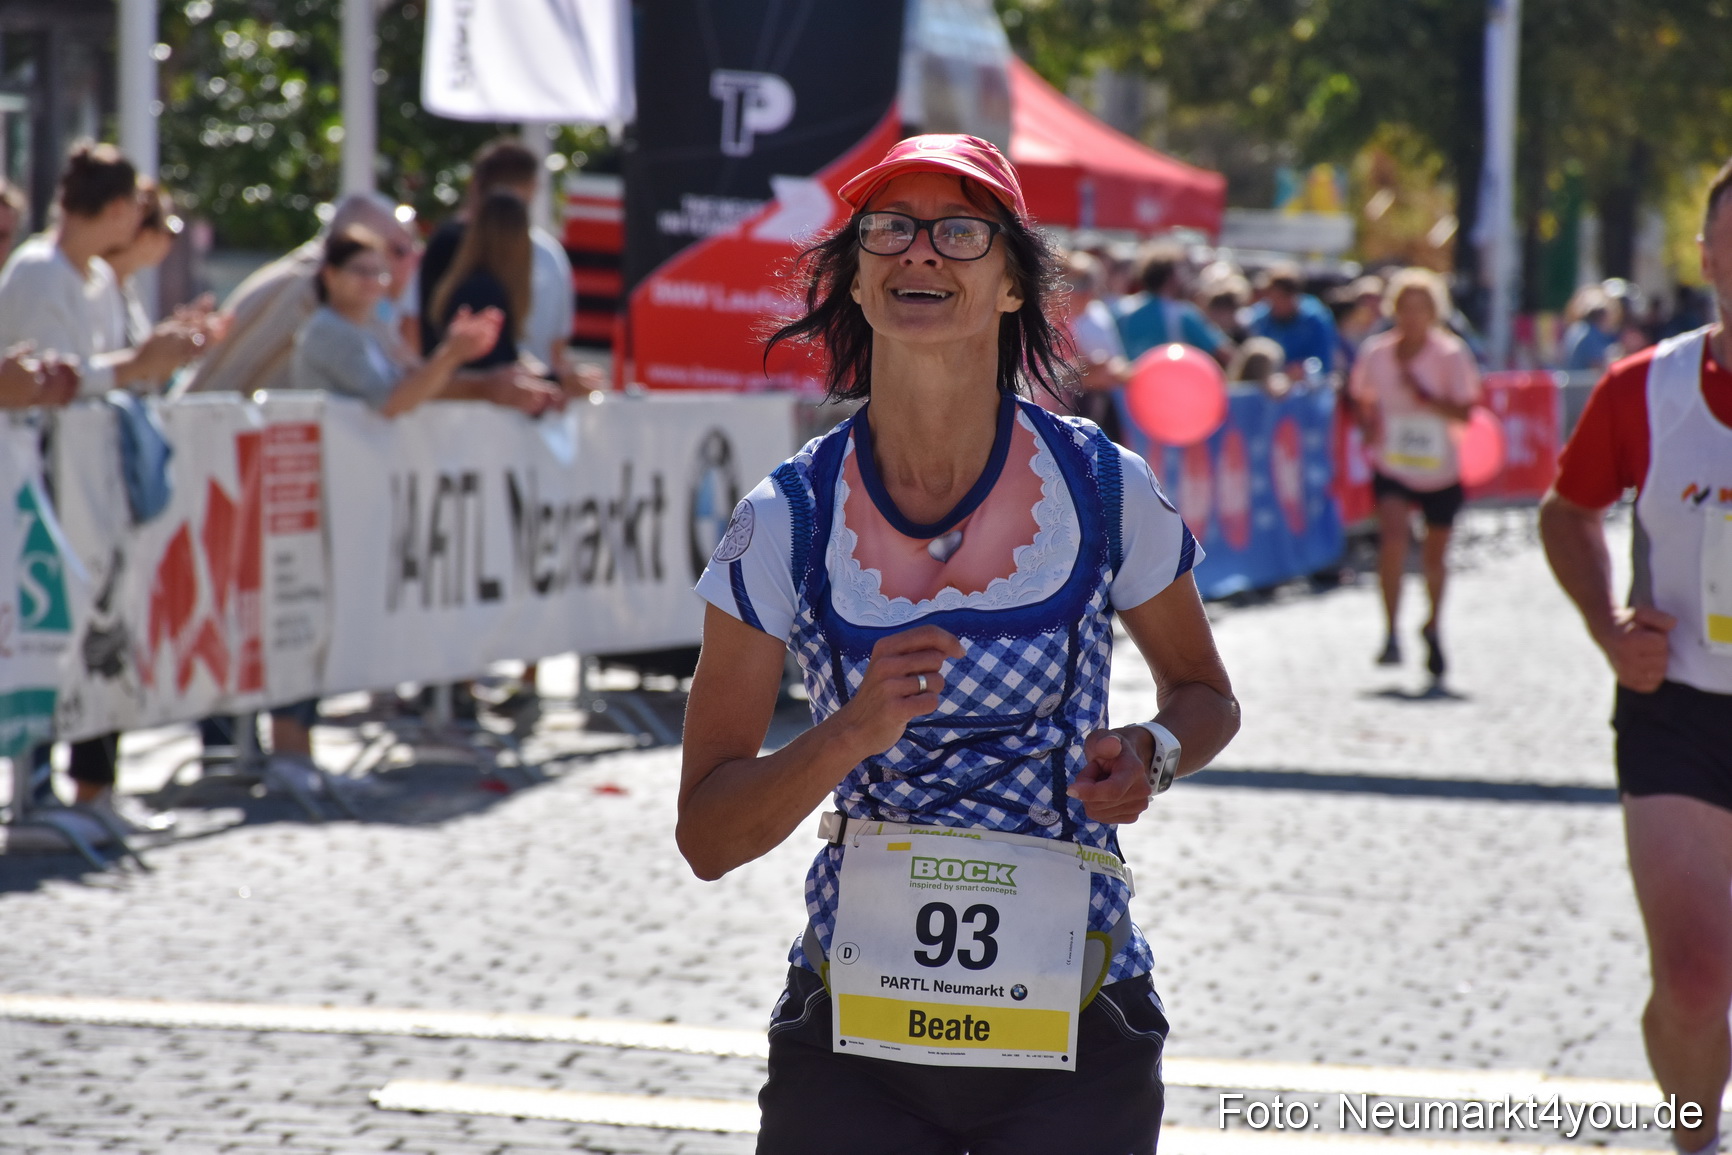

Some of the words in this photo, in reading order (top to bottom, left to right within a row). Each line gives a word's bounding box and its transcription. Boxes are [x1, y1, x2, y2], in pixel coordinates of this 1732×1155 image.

[910, 856, 1018, 887] BOCK
[909, 881, 942, 891] inspired
[943, 883, 954, 892] by
[980, 886, 1017, 896] concepts
[914, 902, 1000, 970] 93
[843, 947, 853, 959] D
[880, 975, 930, 992] PARTL
[933, 980, 1005, 998] Neumarkt
[908, 1009, 991, 1041] Beate
